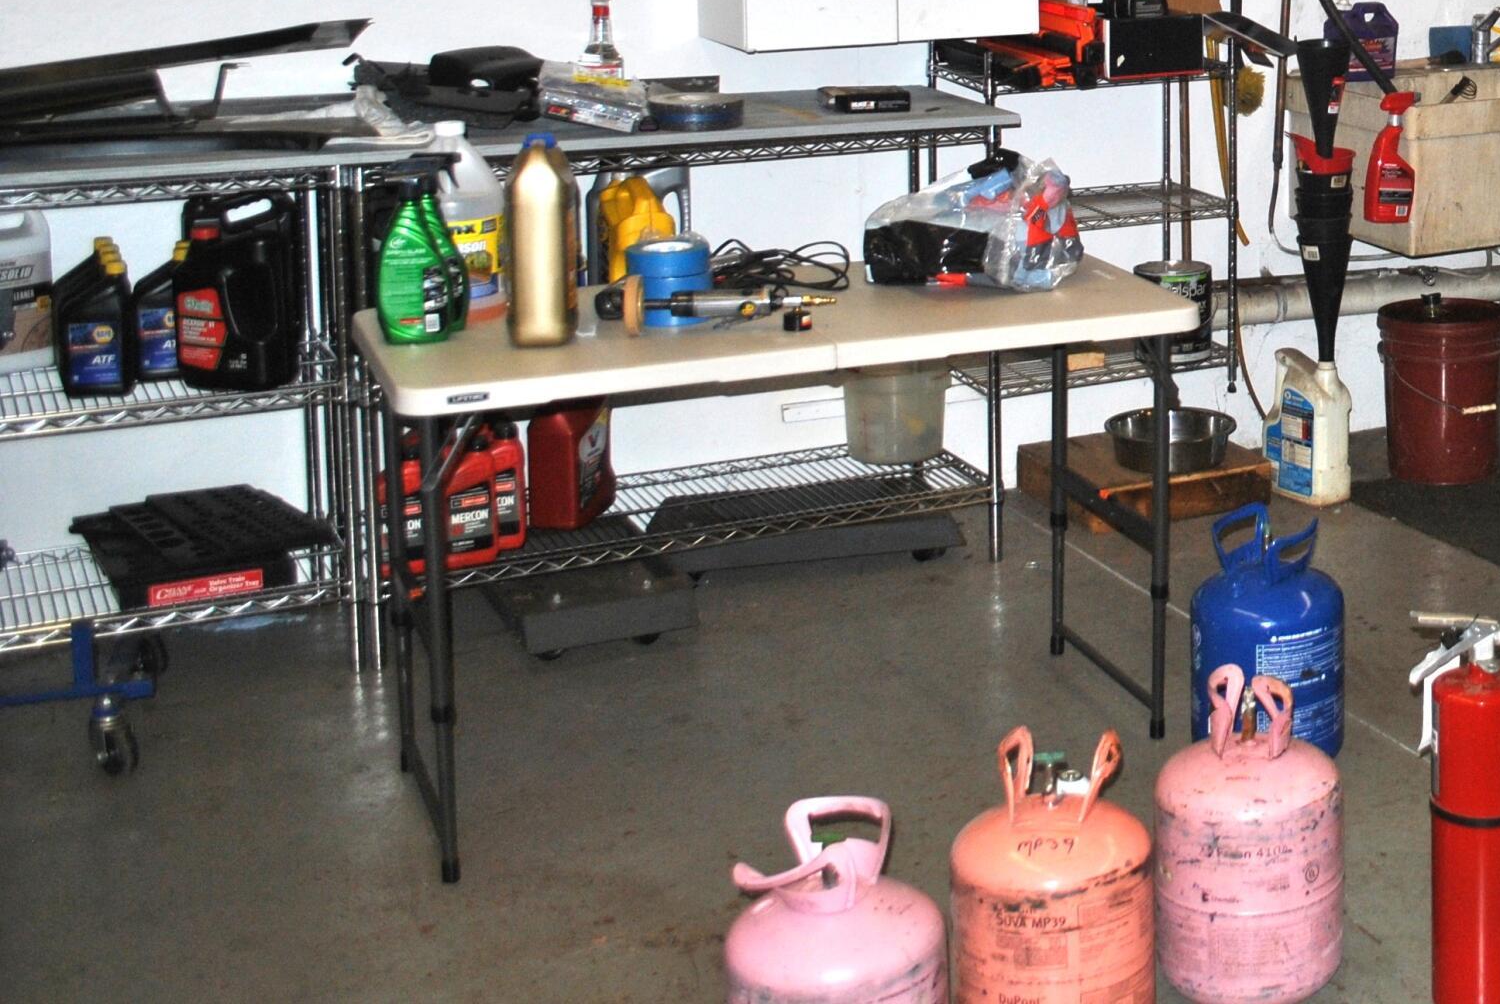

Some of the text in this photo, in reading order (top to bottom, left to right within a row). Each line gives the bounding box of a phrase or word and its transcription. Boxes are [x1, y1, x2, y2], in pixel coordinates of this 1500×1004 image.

[92, 354, 116, 365] ATF
[450, 508, 490, 525] MERCON
[228, 576, 246, 584] Train
[209, 582, 244, 593] Organizer
[996, 914, 1067, 929] SUVA MP39
